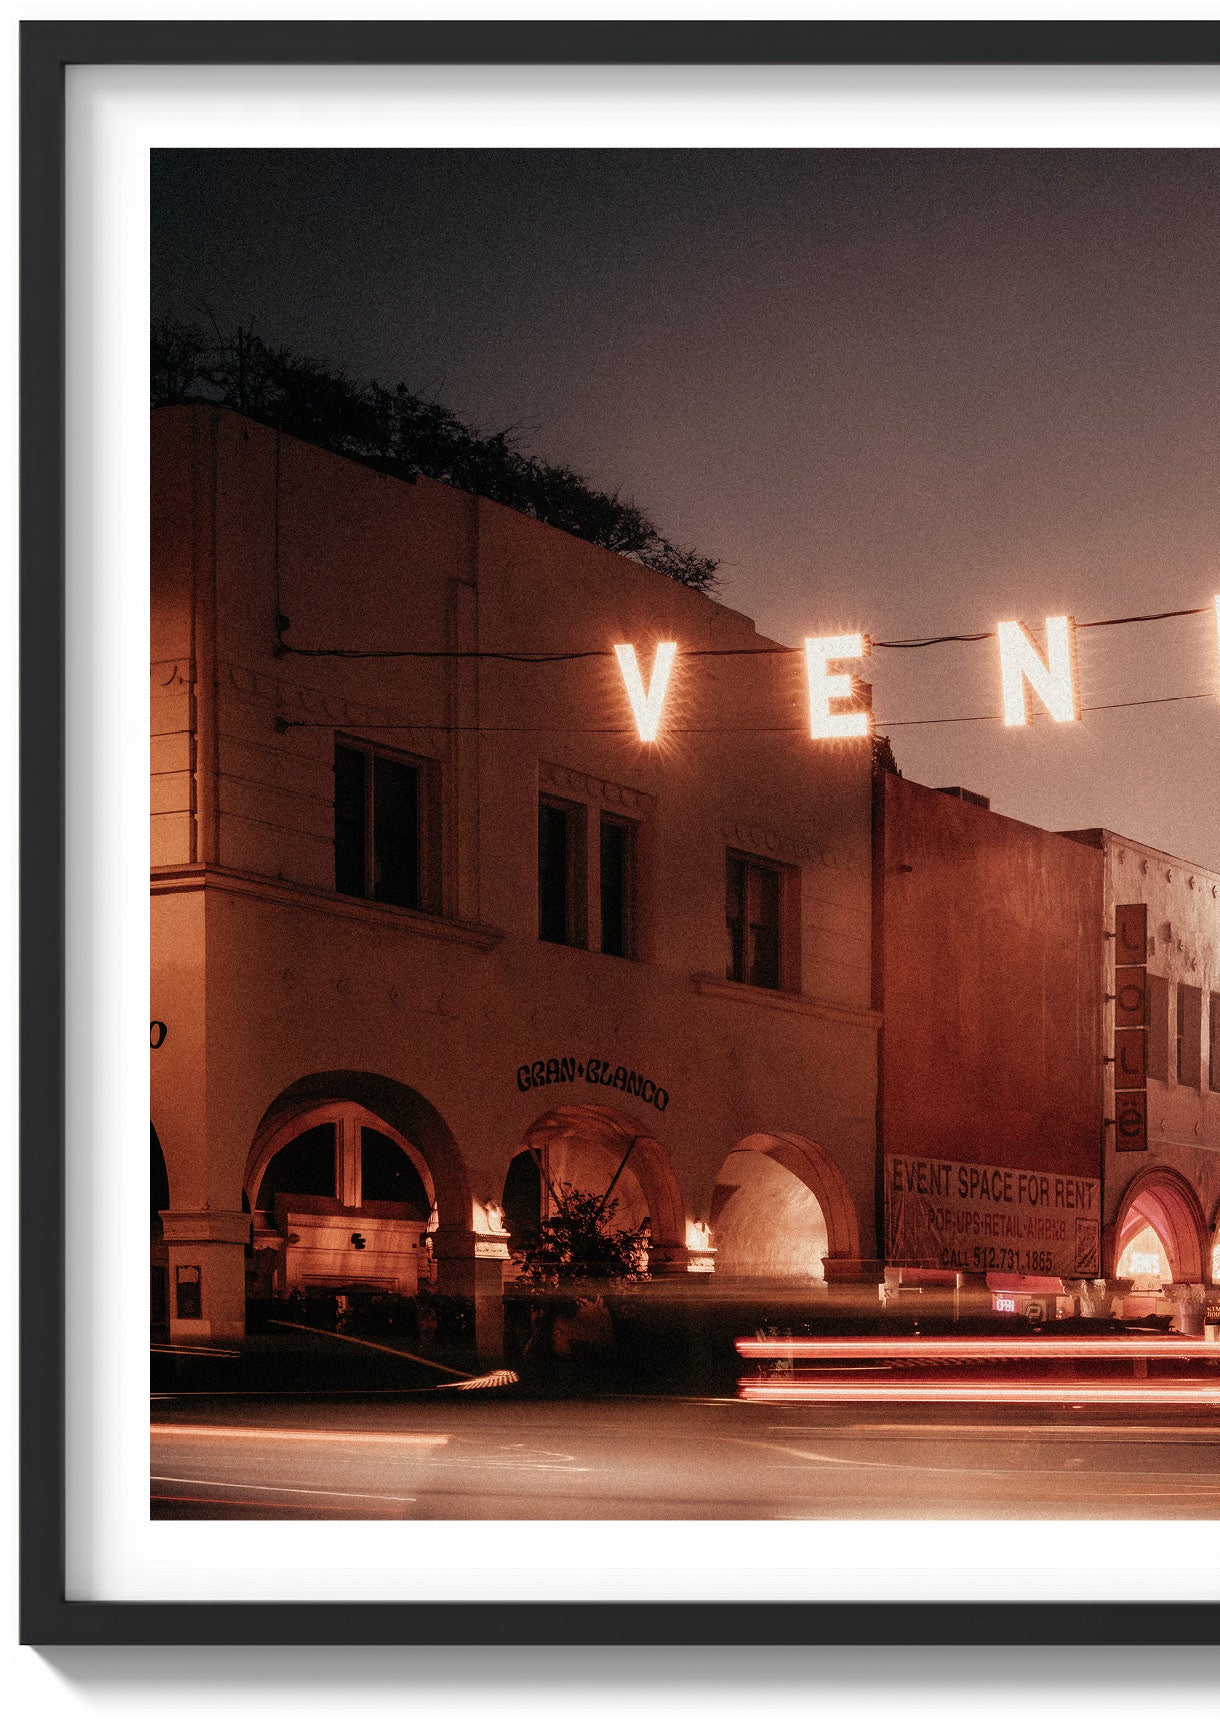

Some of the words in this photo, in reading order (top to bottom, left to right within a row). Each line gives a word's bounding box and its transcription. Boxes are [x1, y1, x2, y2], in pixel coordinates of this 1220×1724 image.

[516, 1057, 576, 1092] GRAN
[586, 1058, 670, 1112] BLANCO
[892, 1158, 952, 1198] EVENT
[957, 1166, 1013, 1203] SPACE
[1018, 1173, 1051, 1206] FOR
[1055, 1178, 1097, 1211] RENT
[942, 1247, 970, 1267] CALL
